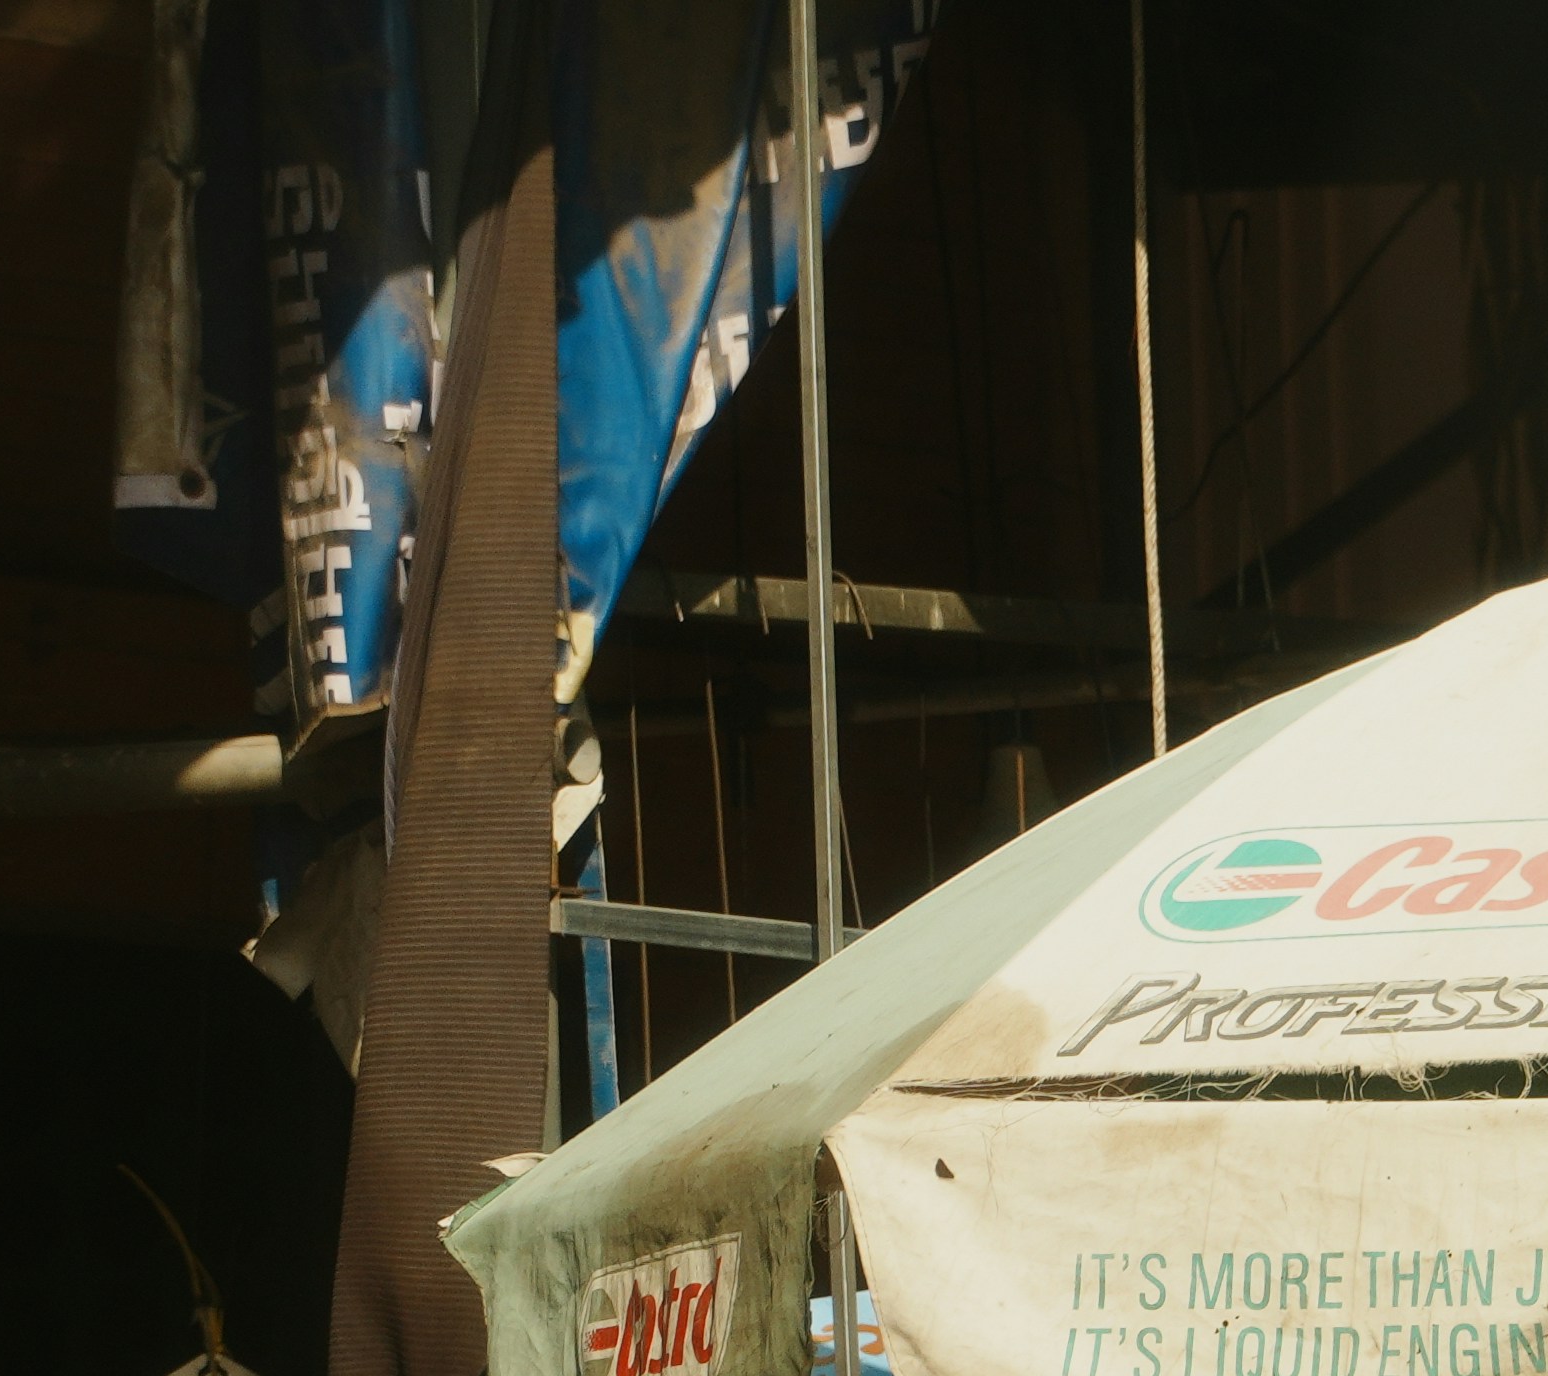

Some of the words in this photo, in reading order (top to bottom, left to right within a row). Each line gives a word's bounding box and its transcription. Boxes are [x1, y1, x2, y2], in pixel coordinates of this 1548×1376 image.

[1072, 1252, 1168, 1312] IT'S
[1188, 1251, 1345, 1312] MORE
[1363, 1248, 1496, 1310] THAN
